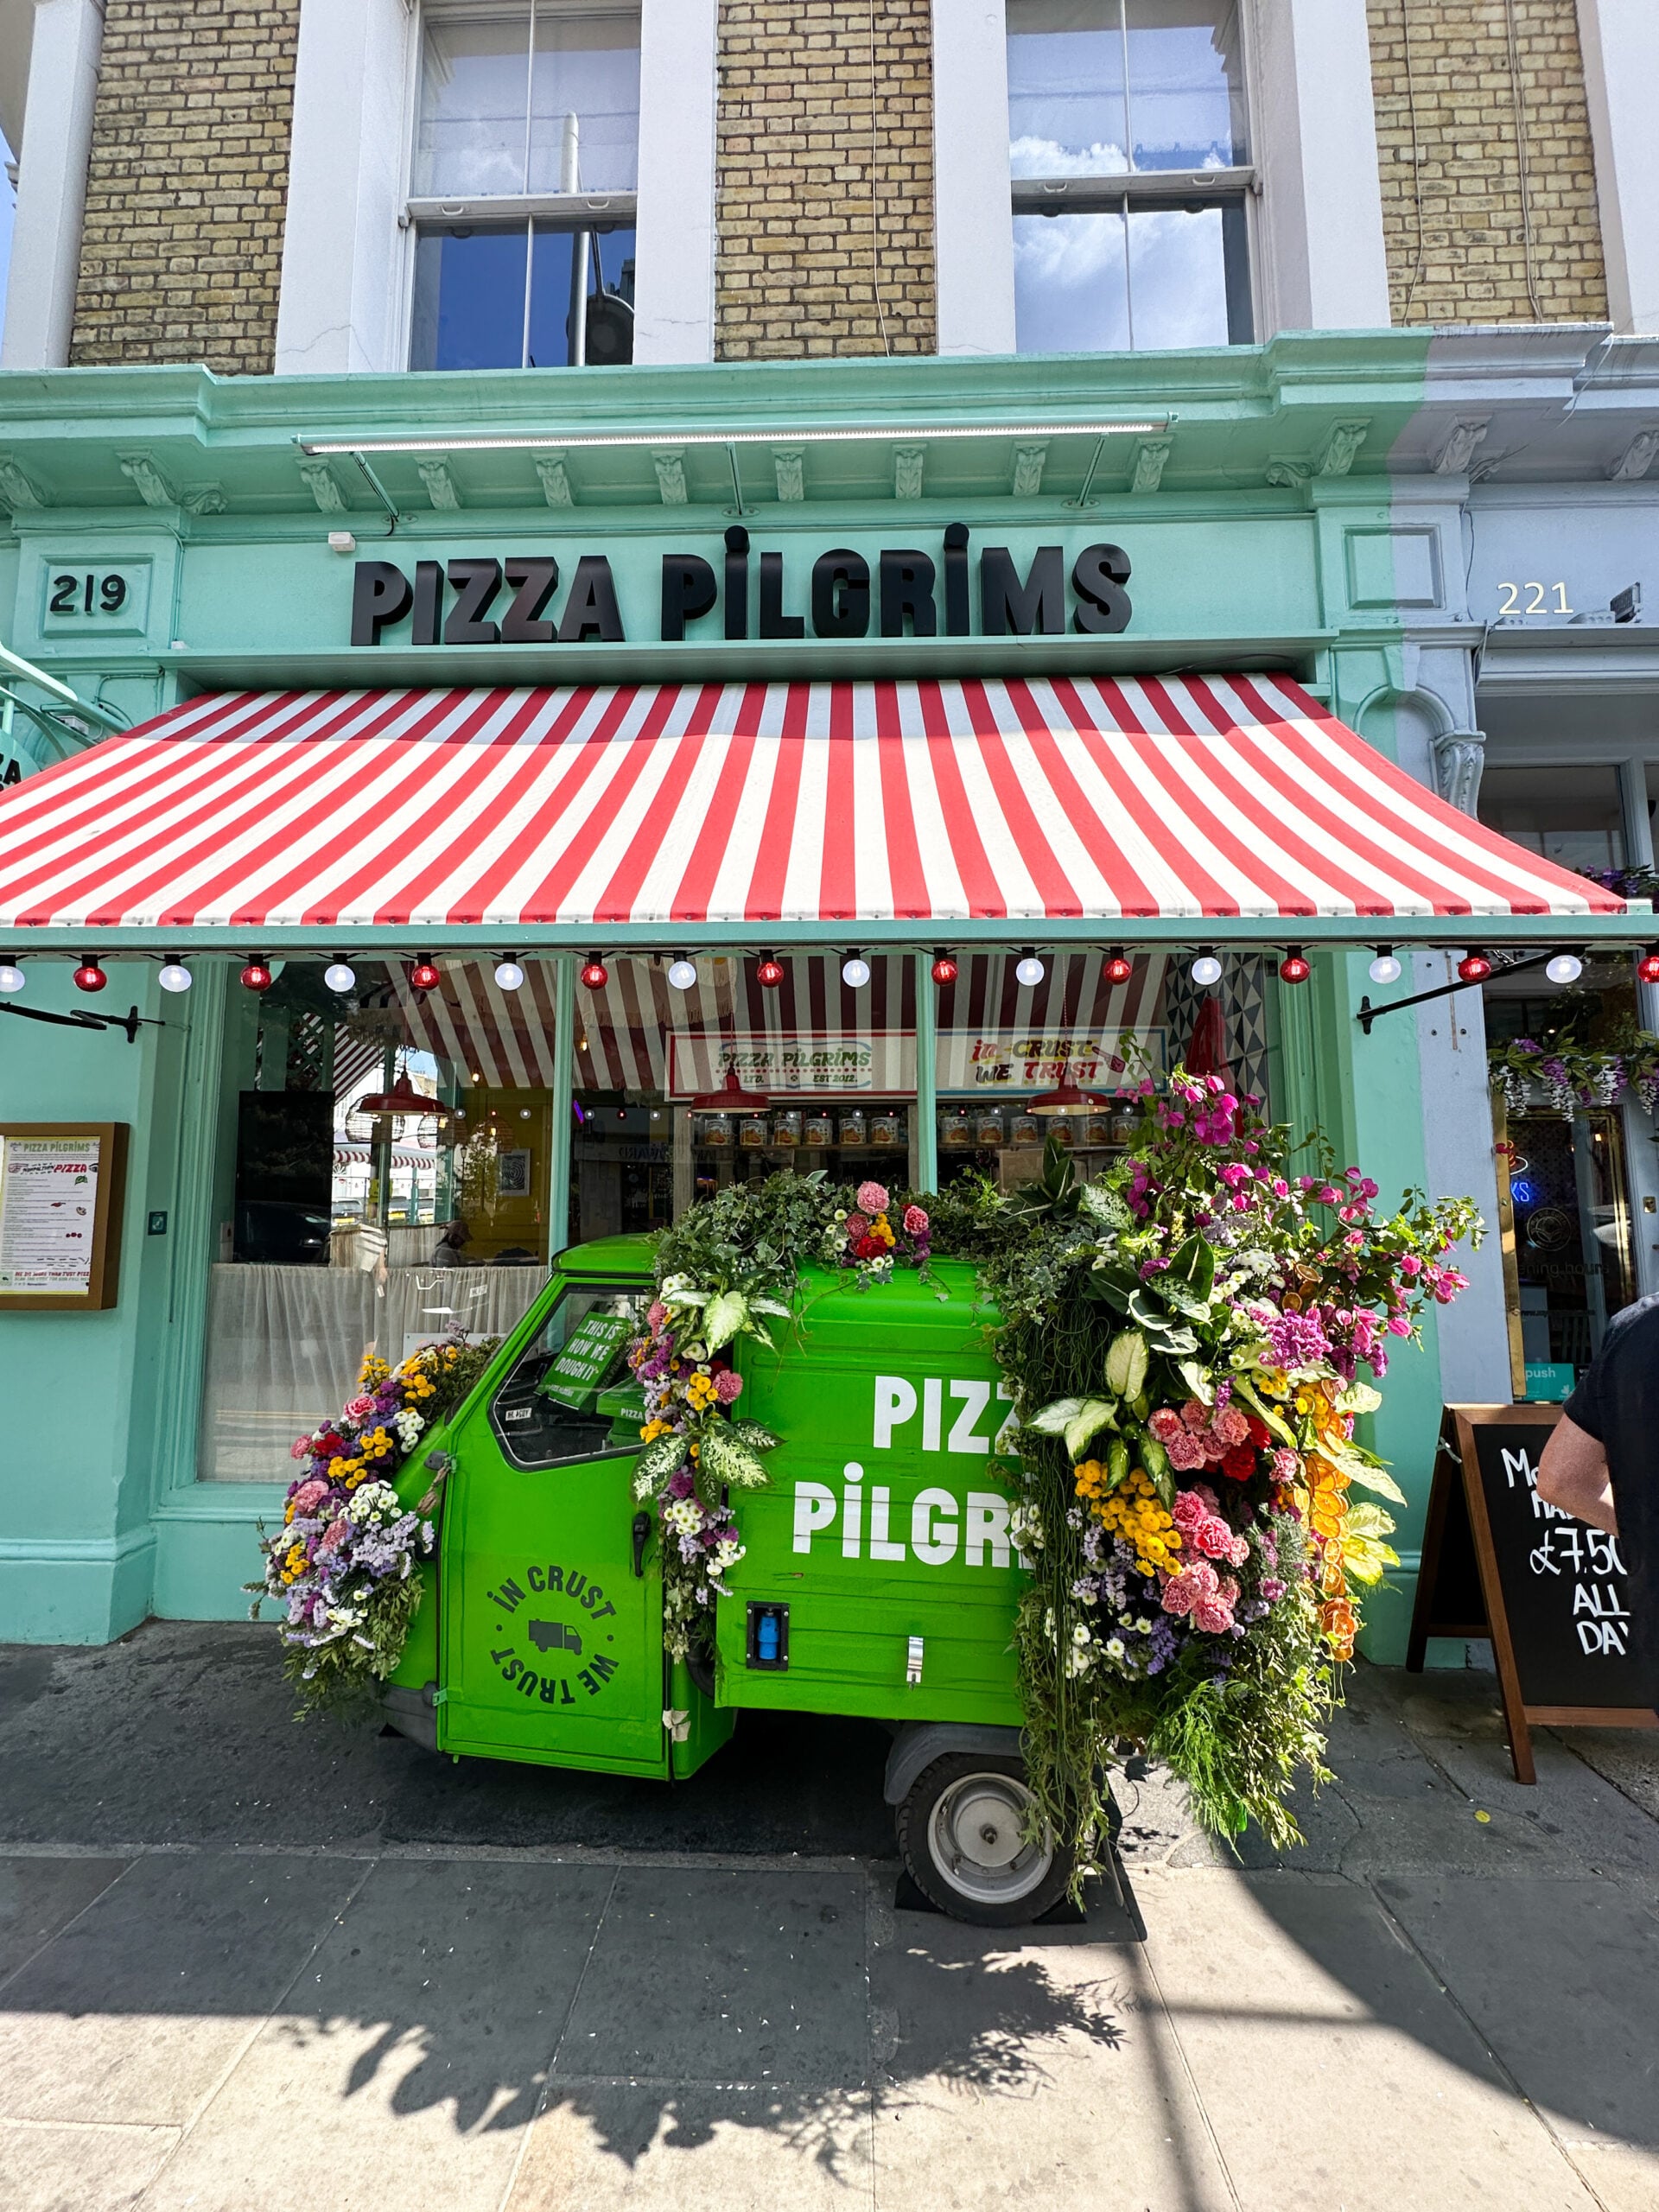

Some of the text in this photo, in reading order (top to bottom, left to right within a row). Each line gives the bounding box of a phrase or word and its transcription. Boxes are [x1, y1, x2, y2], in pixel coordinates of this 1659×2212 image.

[49, 574, 127, 612] 219
[351, 556, 626, 646] PIZZA
[1497, 582, 1574, 615] 221
[1012, 1039, 1093, 1058] CRUST
[718, 1052, 774, 1068] PIZZA
[976, 1061, 1104, 1083] WE TRUST
[23, 1142, 48, 1153] PIZZA
[54, 1163, 87, 1173] PIZZA
[583, 1320, 620, 1340] THIS IS
[567, 1338, 610, 1362] HOW WE
[555, 1357, 588, 1378] DOUGH
[1525, 1367, 1556, 1381] push
[620, 1408, 644, 1421] PIZZA
[527, 1565, 617, 1620] CRUST
[1573, 1583, 1631, 1618] ALL
[490, 1647, 620, 1705] WE TRUST
